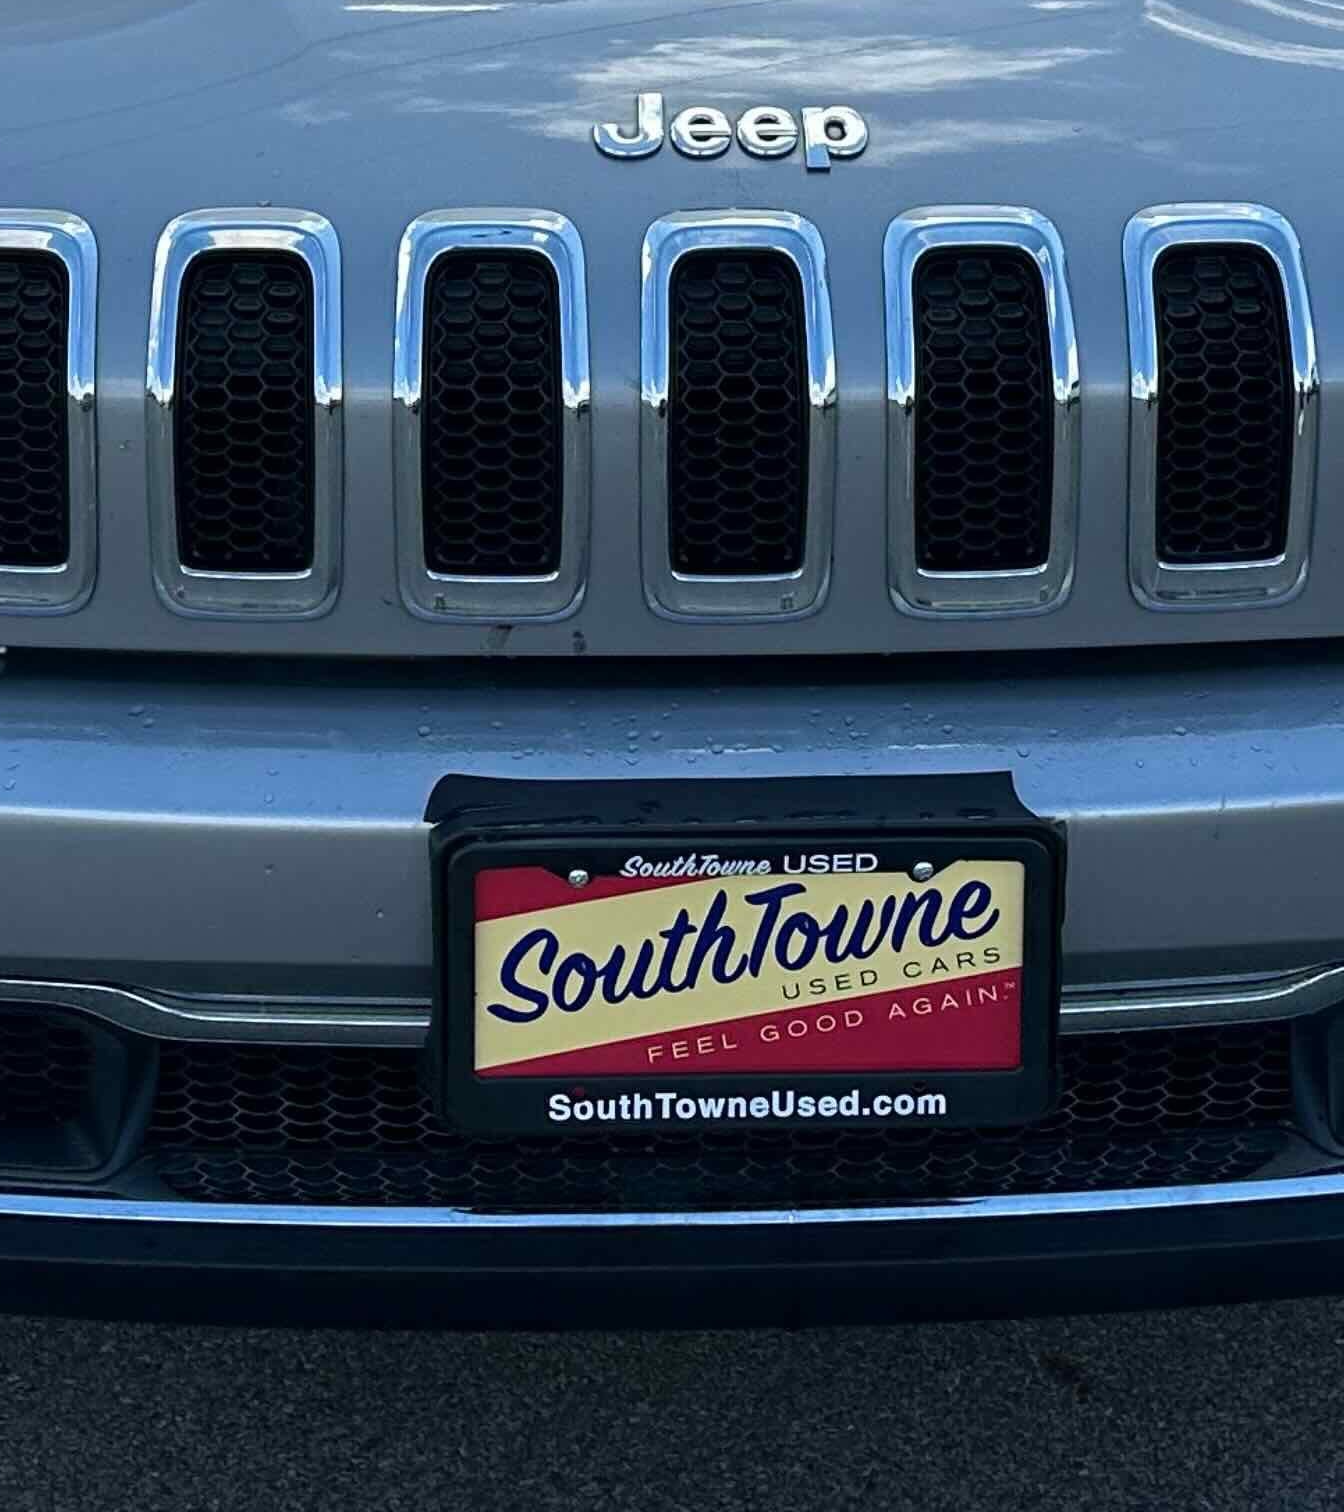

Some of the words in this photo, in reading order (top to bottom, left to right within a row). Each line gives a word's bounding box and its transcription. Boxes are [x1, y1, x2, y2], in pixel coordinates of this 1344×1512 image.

[593, 92, 869, 172] Jeep
[619, 852, 771, 877] SouthTowne
[783, 853, 878, 874] USED
[486, 880, 1000, 1024] SouthTowne
[782, 969, 879, 1001] USED
[903, 947, 1001, 979] CARS
[647, 1034, 738, 1065] FEEL
[759, 1010, 864, 1042] GOOD
[548, 1090, 948, 1121] SouthTowneUsed.com
